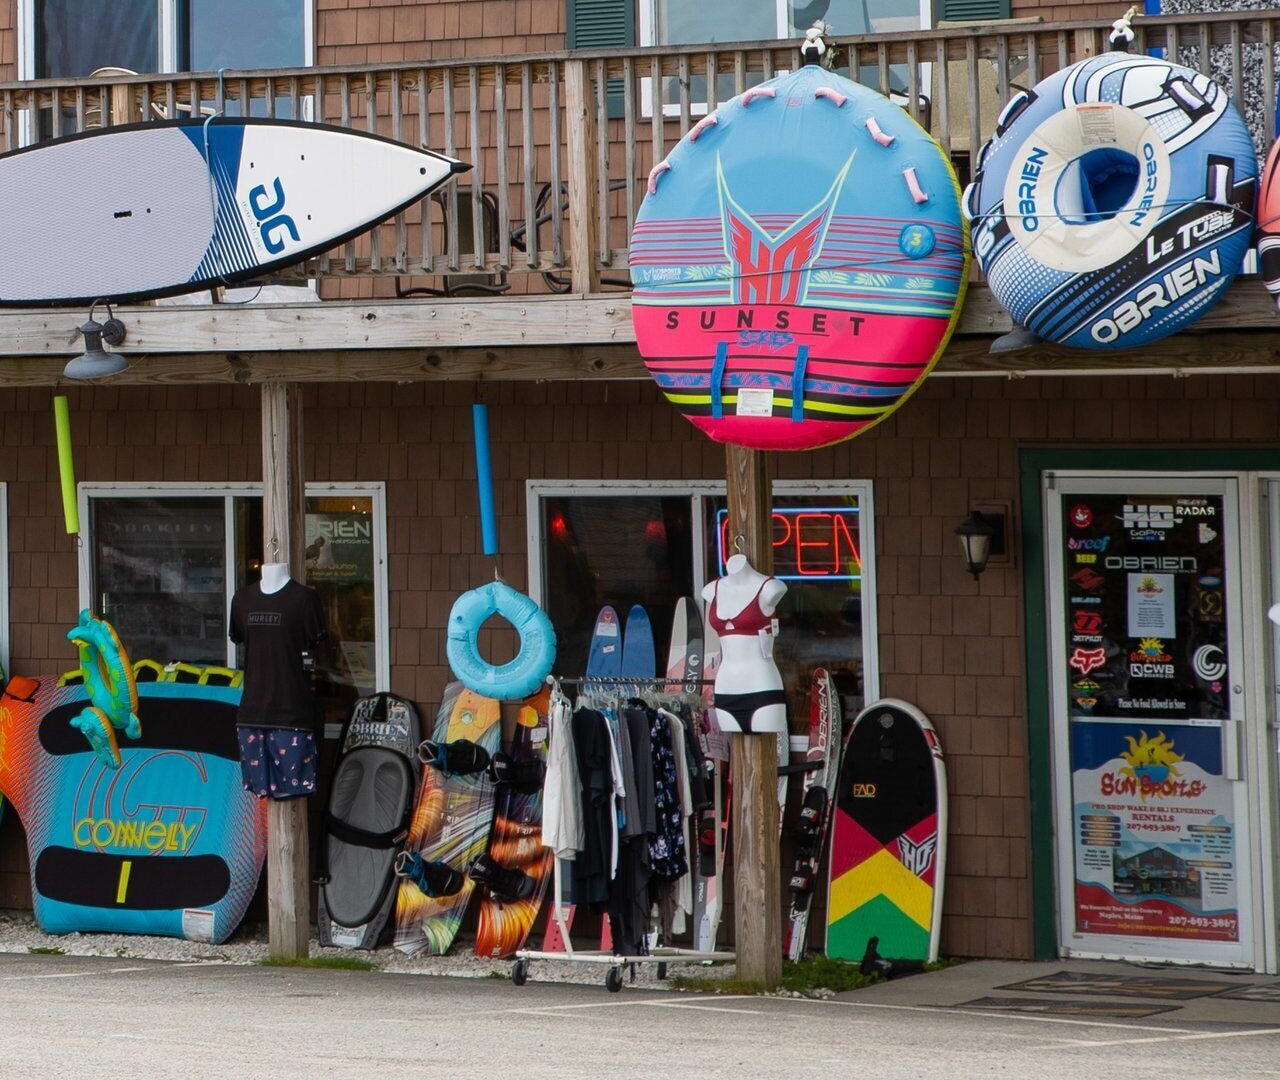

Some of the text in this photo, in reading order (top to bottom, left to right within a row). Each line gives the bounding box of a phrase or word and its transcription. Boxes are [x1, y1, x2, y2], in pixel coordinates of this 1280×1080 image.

[1018, 146, 1049, 232] OBRIEN
[1129, 141, 1160, 227] OBRIEN
[1176, 209, 1235, 250] TUBE
[1090, 248, 1222, 345] OBRIEN
[666, 308, 865, 336] SUNSET
[305, 520, 371, 537] BRIEN
[722, 513, 861, 575] PEN
[1104, 556, 1198, 570] OBRIEN
[1143, 664, 1175, 673] CWB
[349, 723, 409, 737] OBRIEN
[852, 783, 877, 796] FAD
[1132, 813, 1175, 823] RENTALS
[1168, 916, 1236, 929] 207-693-3867
